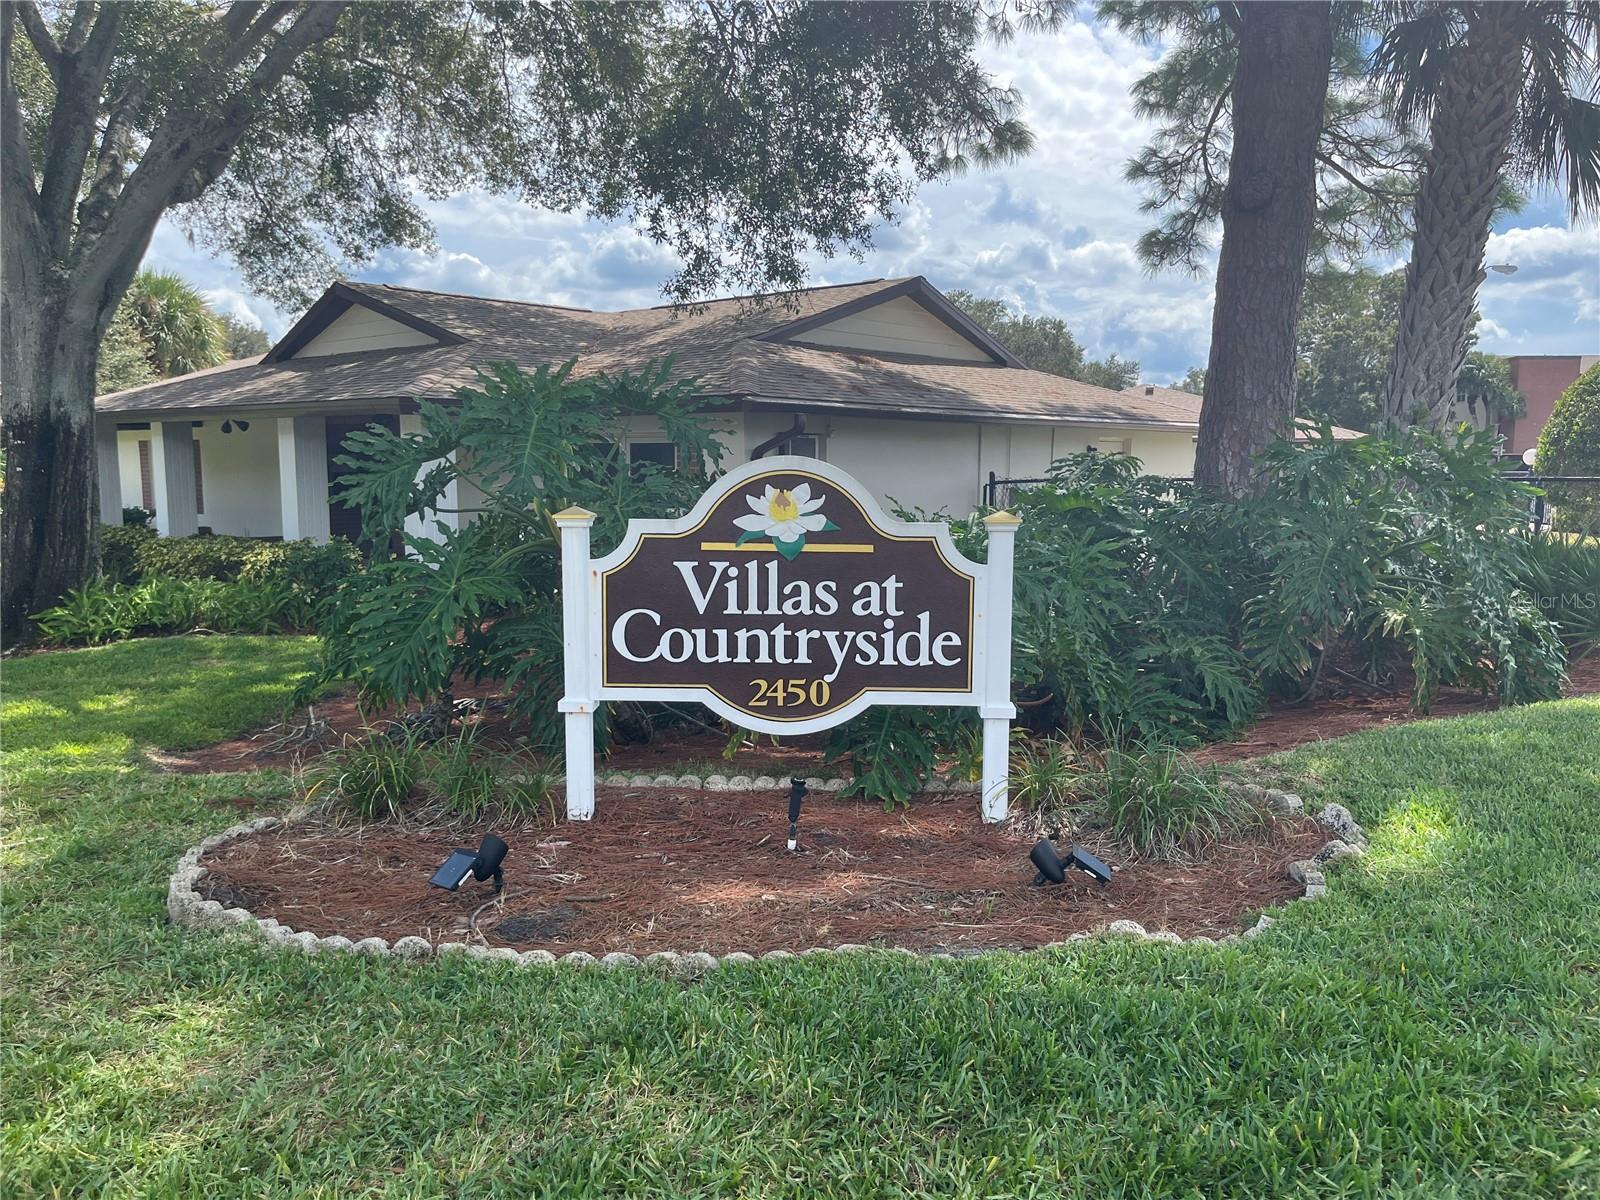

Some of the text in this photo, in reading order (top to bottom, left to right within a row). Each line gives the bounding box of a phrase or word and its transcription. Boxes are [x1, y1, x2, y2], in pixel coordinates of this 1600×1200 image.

[672, 559, 905, 617] Villas at
[611, 608, 963, 683] Countryside
[748, 678, 831, 707] 2450
